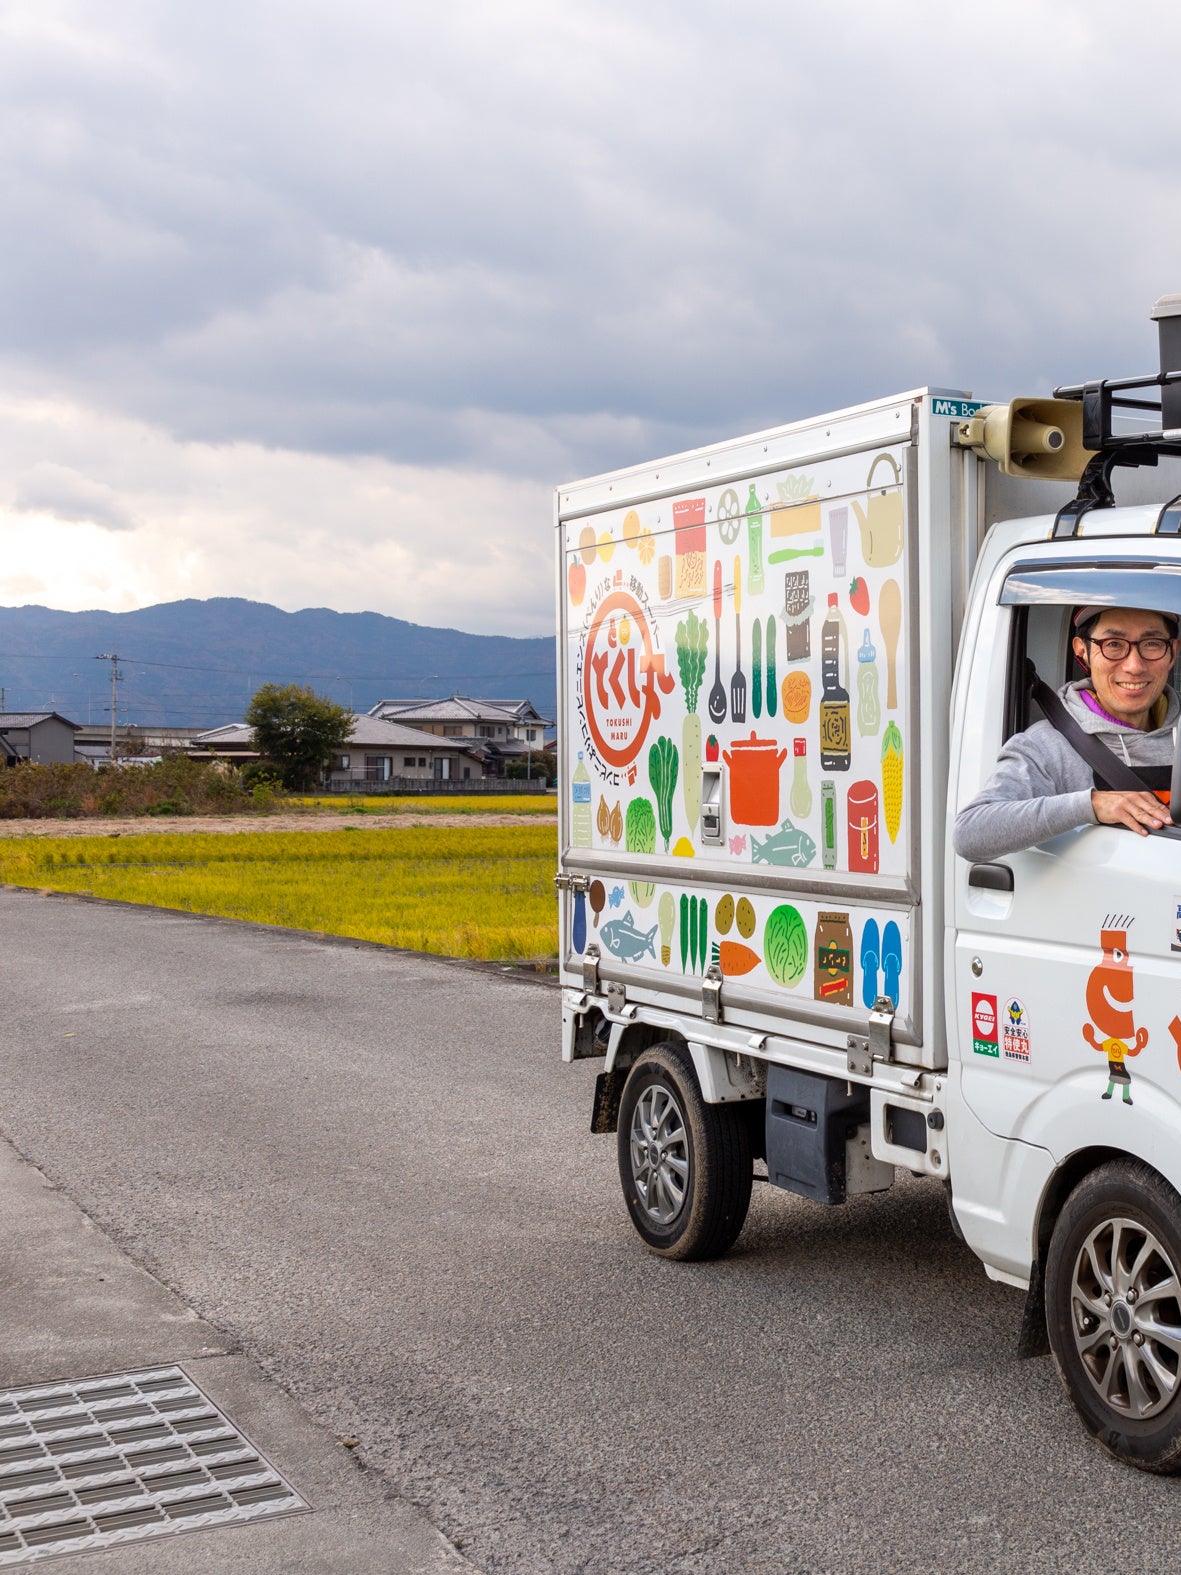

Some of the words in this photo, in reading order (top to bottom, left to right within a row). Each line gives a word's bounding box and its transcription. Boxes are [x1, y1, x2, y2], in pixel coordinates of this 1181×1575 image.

[935, 400, 957, 415] M's
[961, 403, 983, 417] Bo
[629, 574, 660, 649] 移動スーパー
[592, 648, 676, 721] とくし丸
[606, 718, 633, 727] TOKUSHI
[610, 732, 628, 740] MARU
[974, 1013, 996, 1022] KYOEI
[1004, 1026, 1029, 1039] 安全安心
[974, 1041, 998, 1055] キョーエイ
[1005, 1036, 1029, 1053] 特使丸
